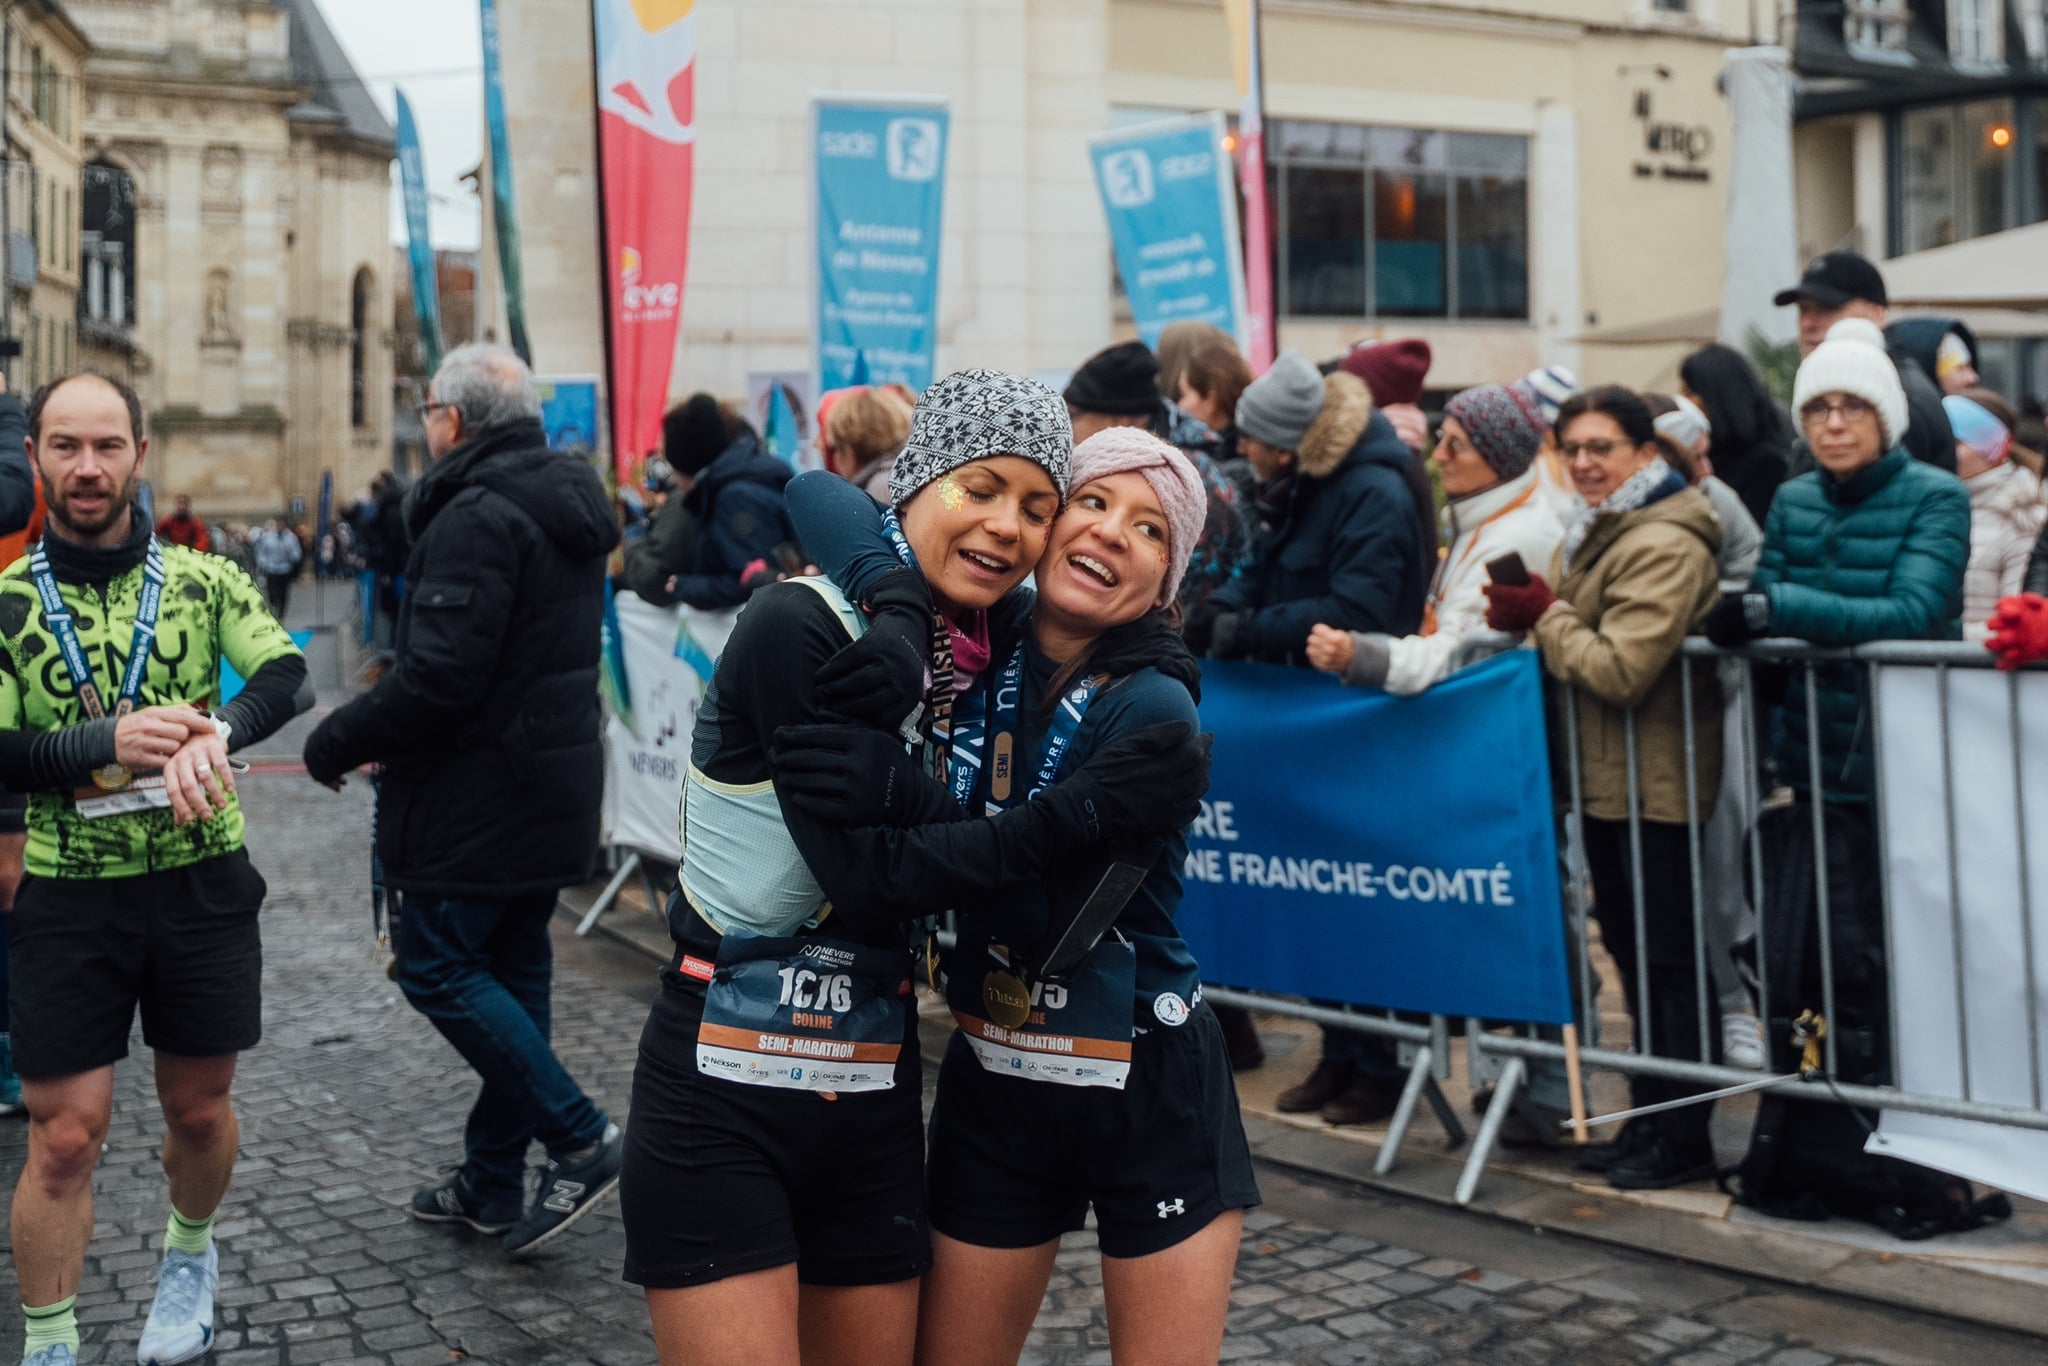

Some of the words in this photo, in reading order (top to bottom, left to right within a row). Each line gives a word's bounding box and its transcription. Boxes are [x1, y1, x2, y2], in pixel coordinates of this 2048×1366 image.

[933, 614, 954, 723] FINISHE
[996, 753, 1009, 779] SEMI
[1228, 851, 1515, 906] FRANCHE-COMTÉ
[819, 954, 853, 967] MARATHON
[821, 947, 856, 961] NEVERS
[792, 1012, 833, 1030] COLINE
[758, 1034, 855, 1058] SEMI-MARATHON
[983, 1023, 1073, 1052] SEMI-MARATHON
[710, 1057, 741, 1070] Nexson
